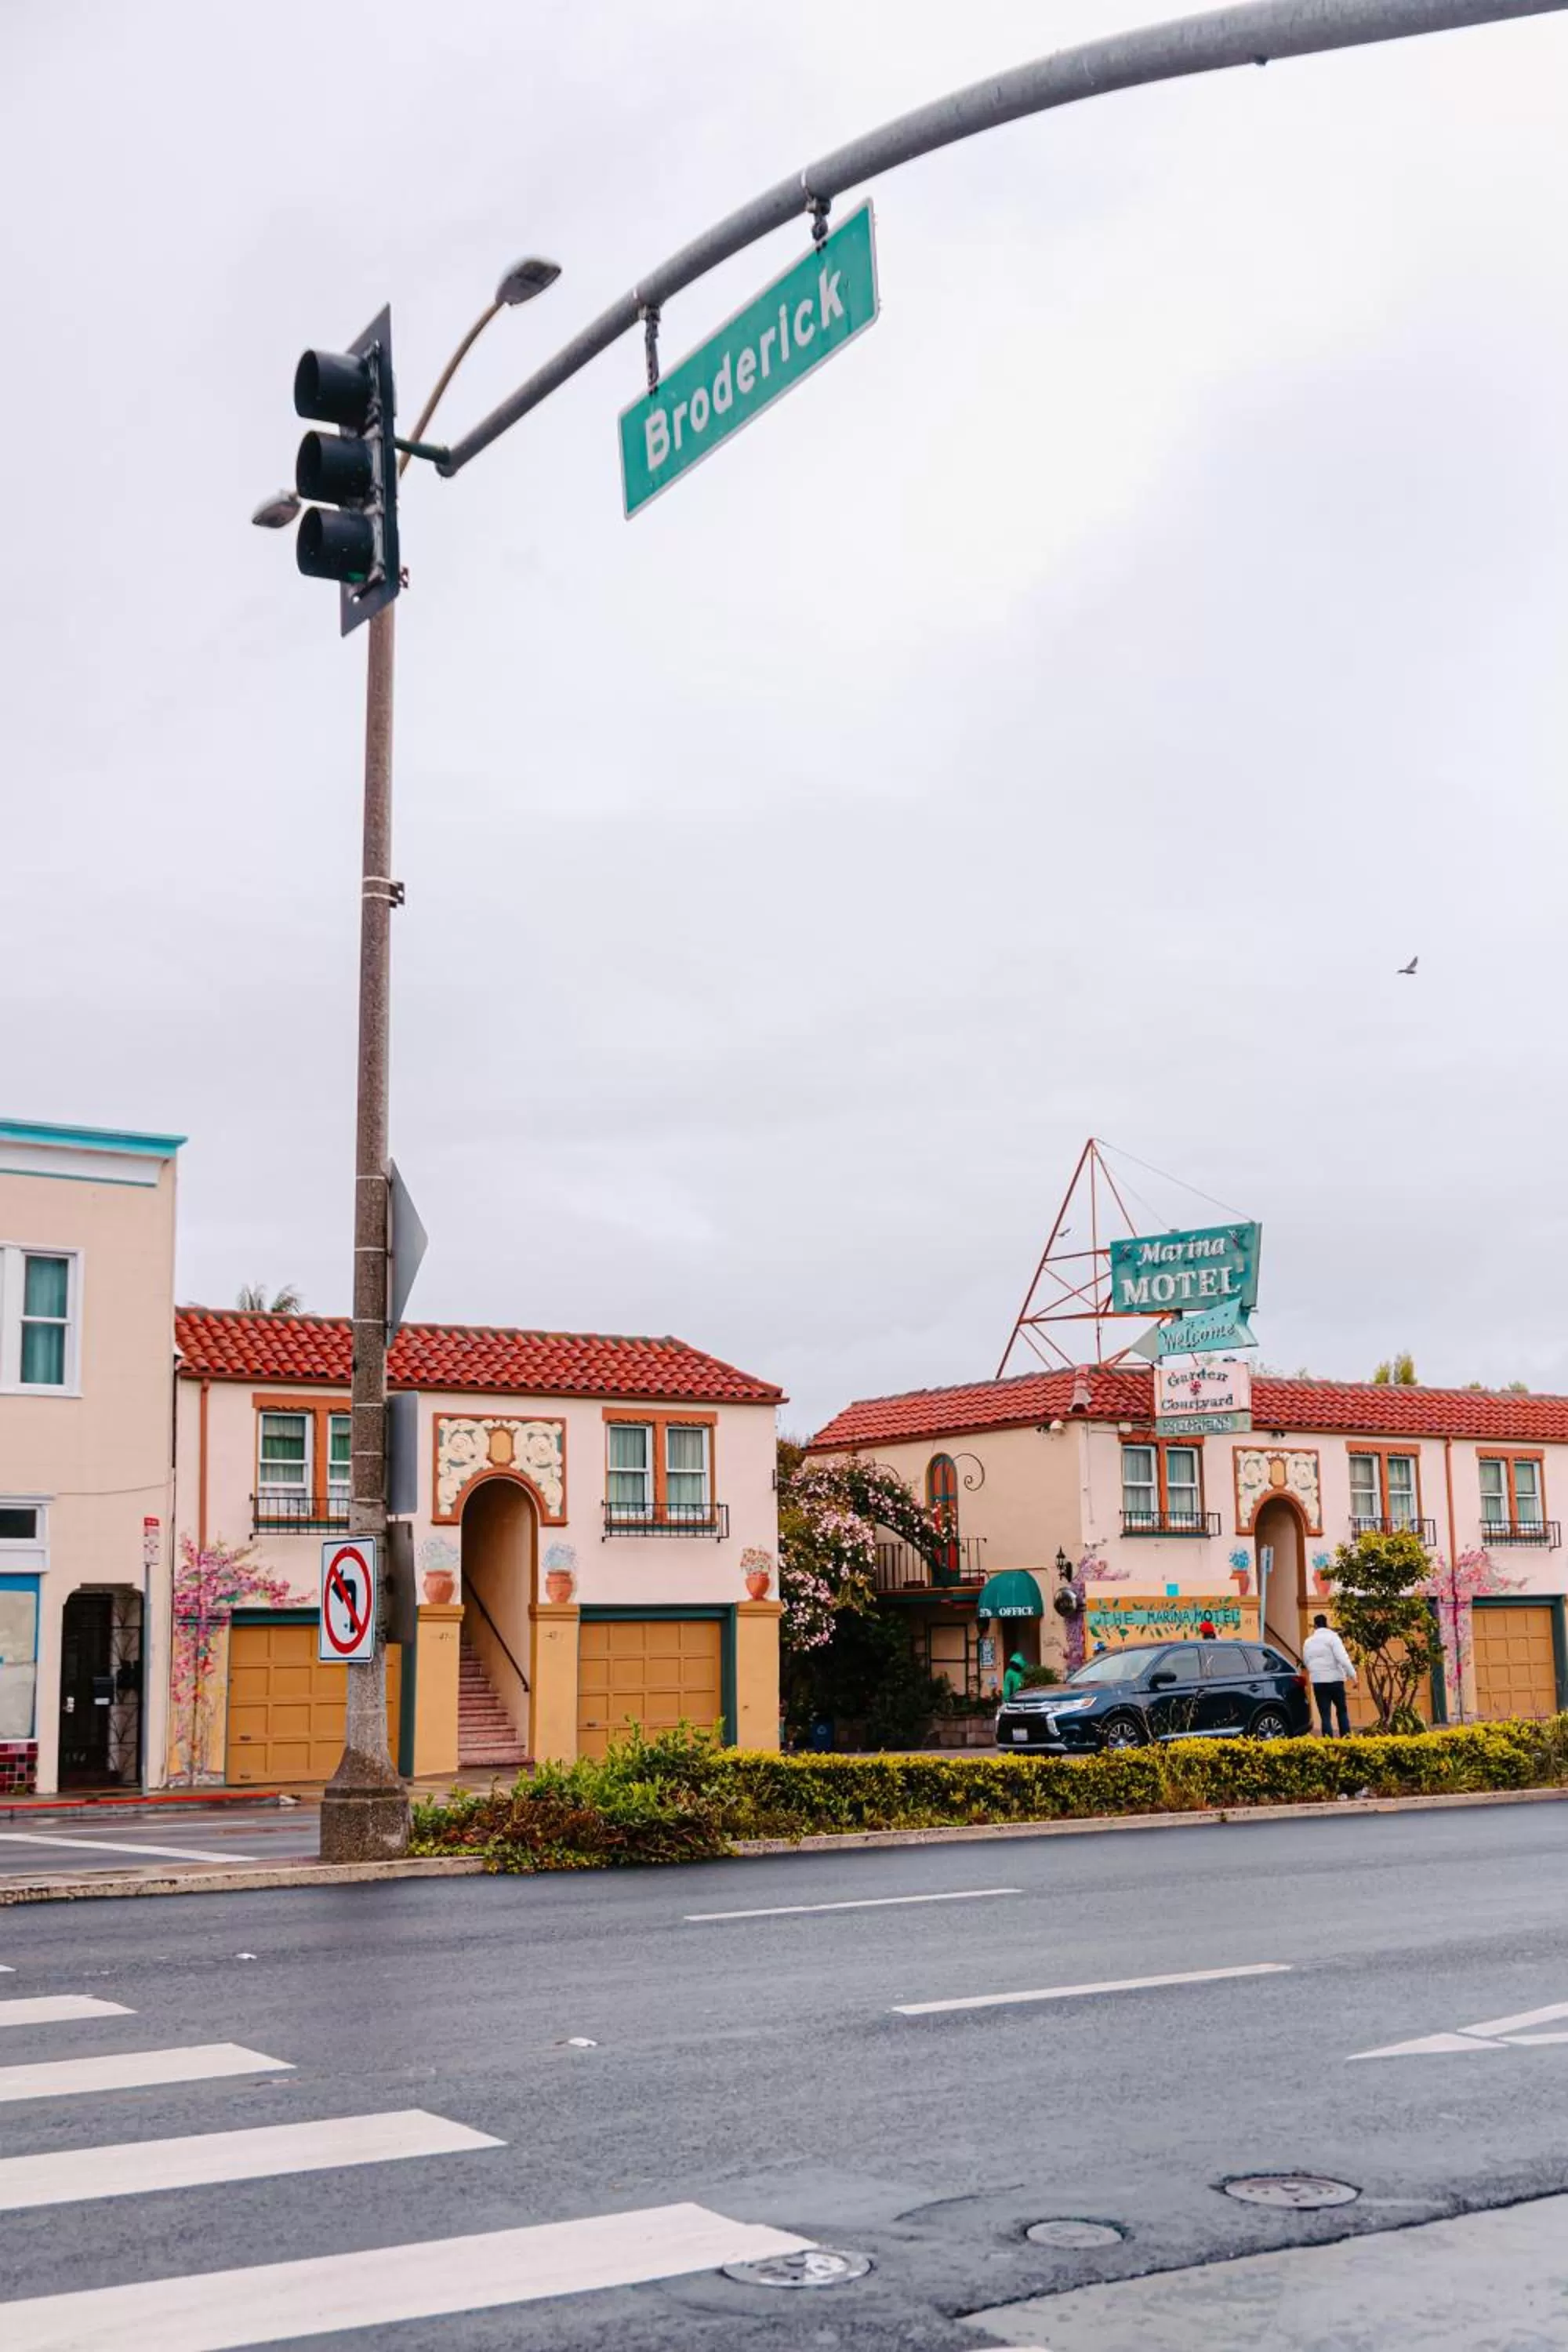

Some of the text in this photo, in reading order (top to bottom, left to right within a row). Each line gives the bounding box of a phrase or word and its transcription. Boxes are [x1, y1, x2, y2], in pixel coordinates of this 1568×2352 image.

[645, 267, 844, 470] Broderick
[1137, 1236, 1225, 1265] Marina
[1120, 1266, 1241, 1305] MOTEL
[1159, 1323, 1236, 1352] Welcome
[1167, 1367, 1229, 1386] Garden
[1162, 1394, 1233, 1410] Courtyard
[998, 1606, 1034, 1616] OFFICE
[1100, 1611, 1134, 1625] THE
[1147, 1610, 1189, 1624] MARINA
[1194, 1609, 1240, 1623] MOTEL
